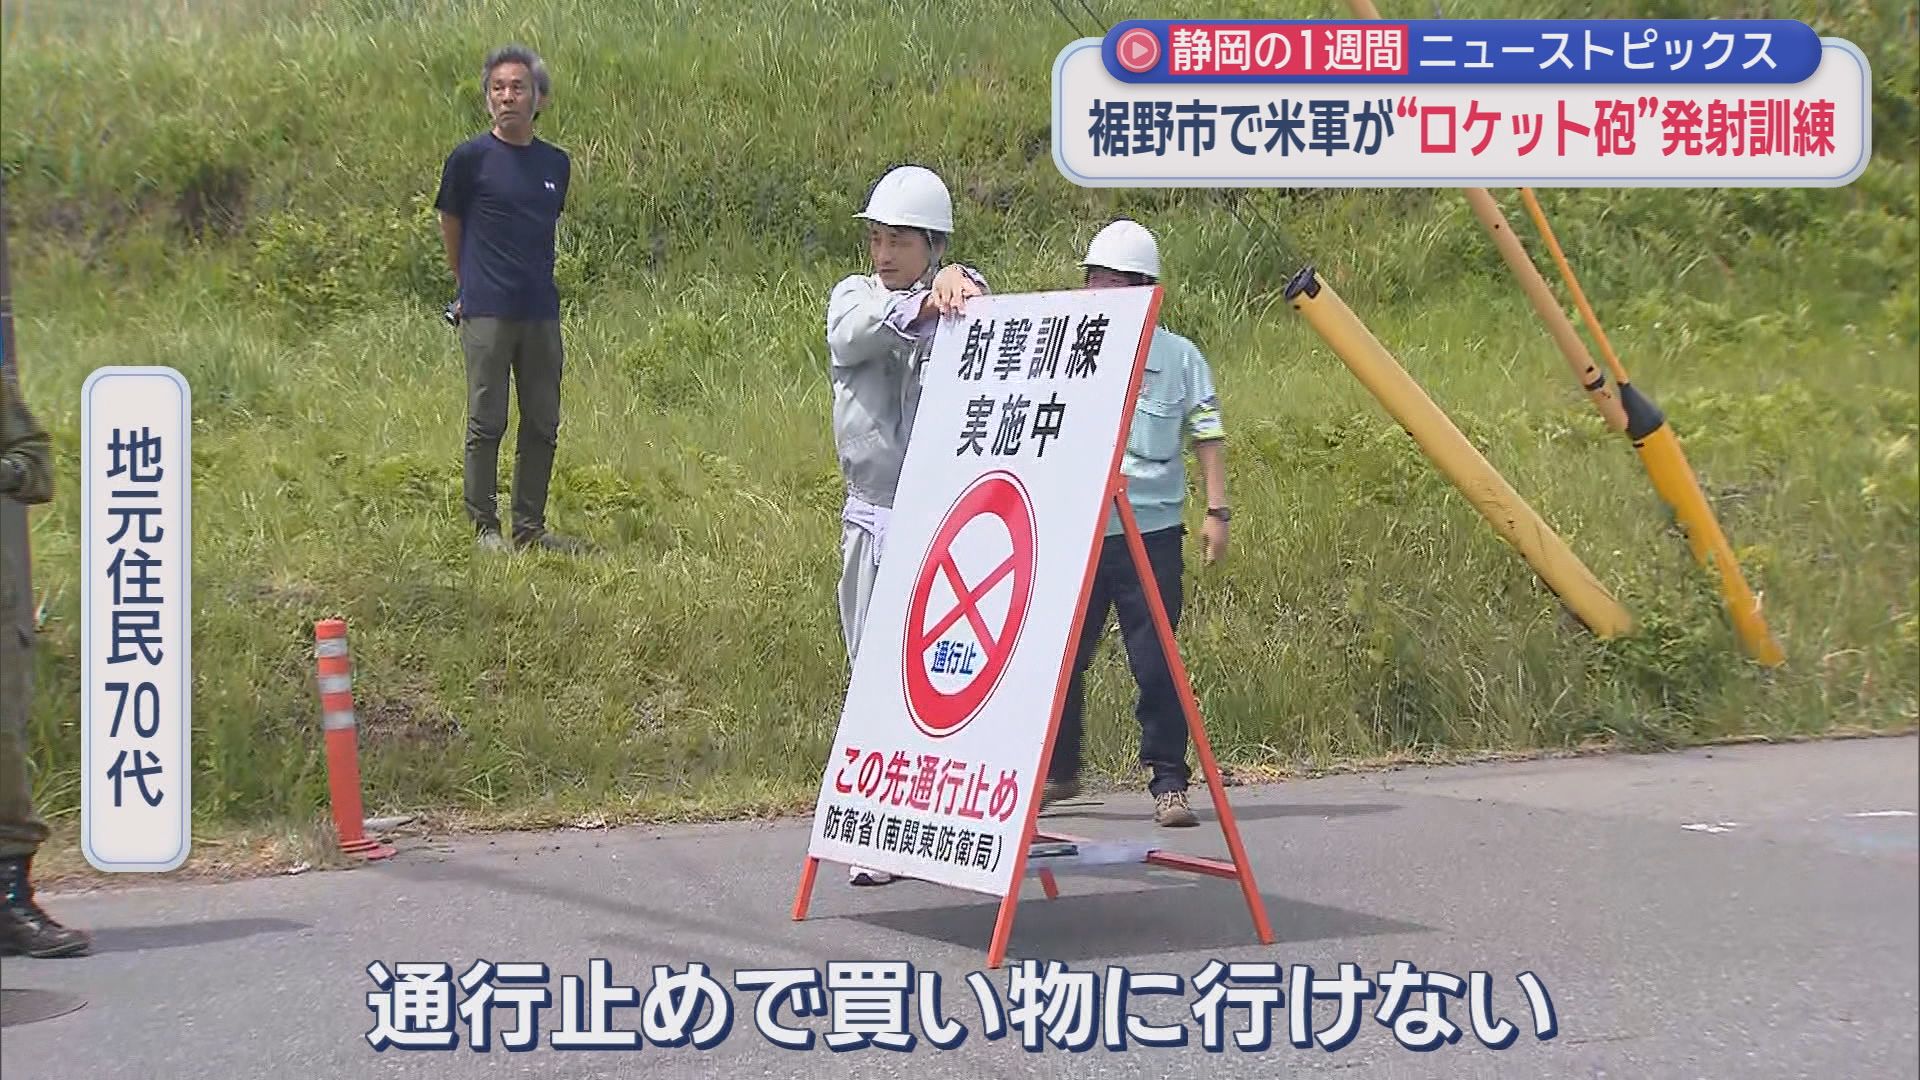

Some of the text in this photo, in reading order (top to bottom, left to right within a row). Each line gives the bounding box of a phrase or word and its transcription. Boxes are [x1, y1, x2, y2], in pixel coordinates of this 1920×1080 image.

[957, 313, 1110, 381] 射撃訓練
[956, 391, 1067, 458] 実施中
[931, 640, 978, 676] 通行止
[835, 747, 1019, 823] この先通行止め
[823, 804, 1003, 873] 防衛省(南関東防衛局)
